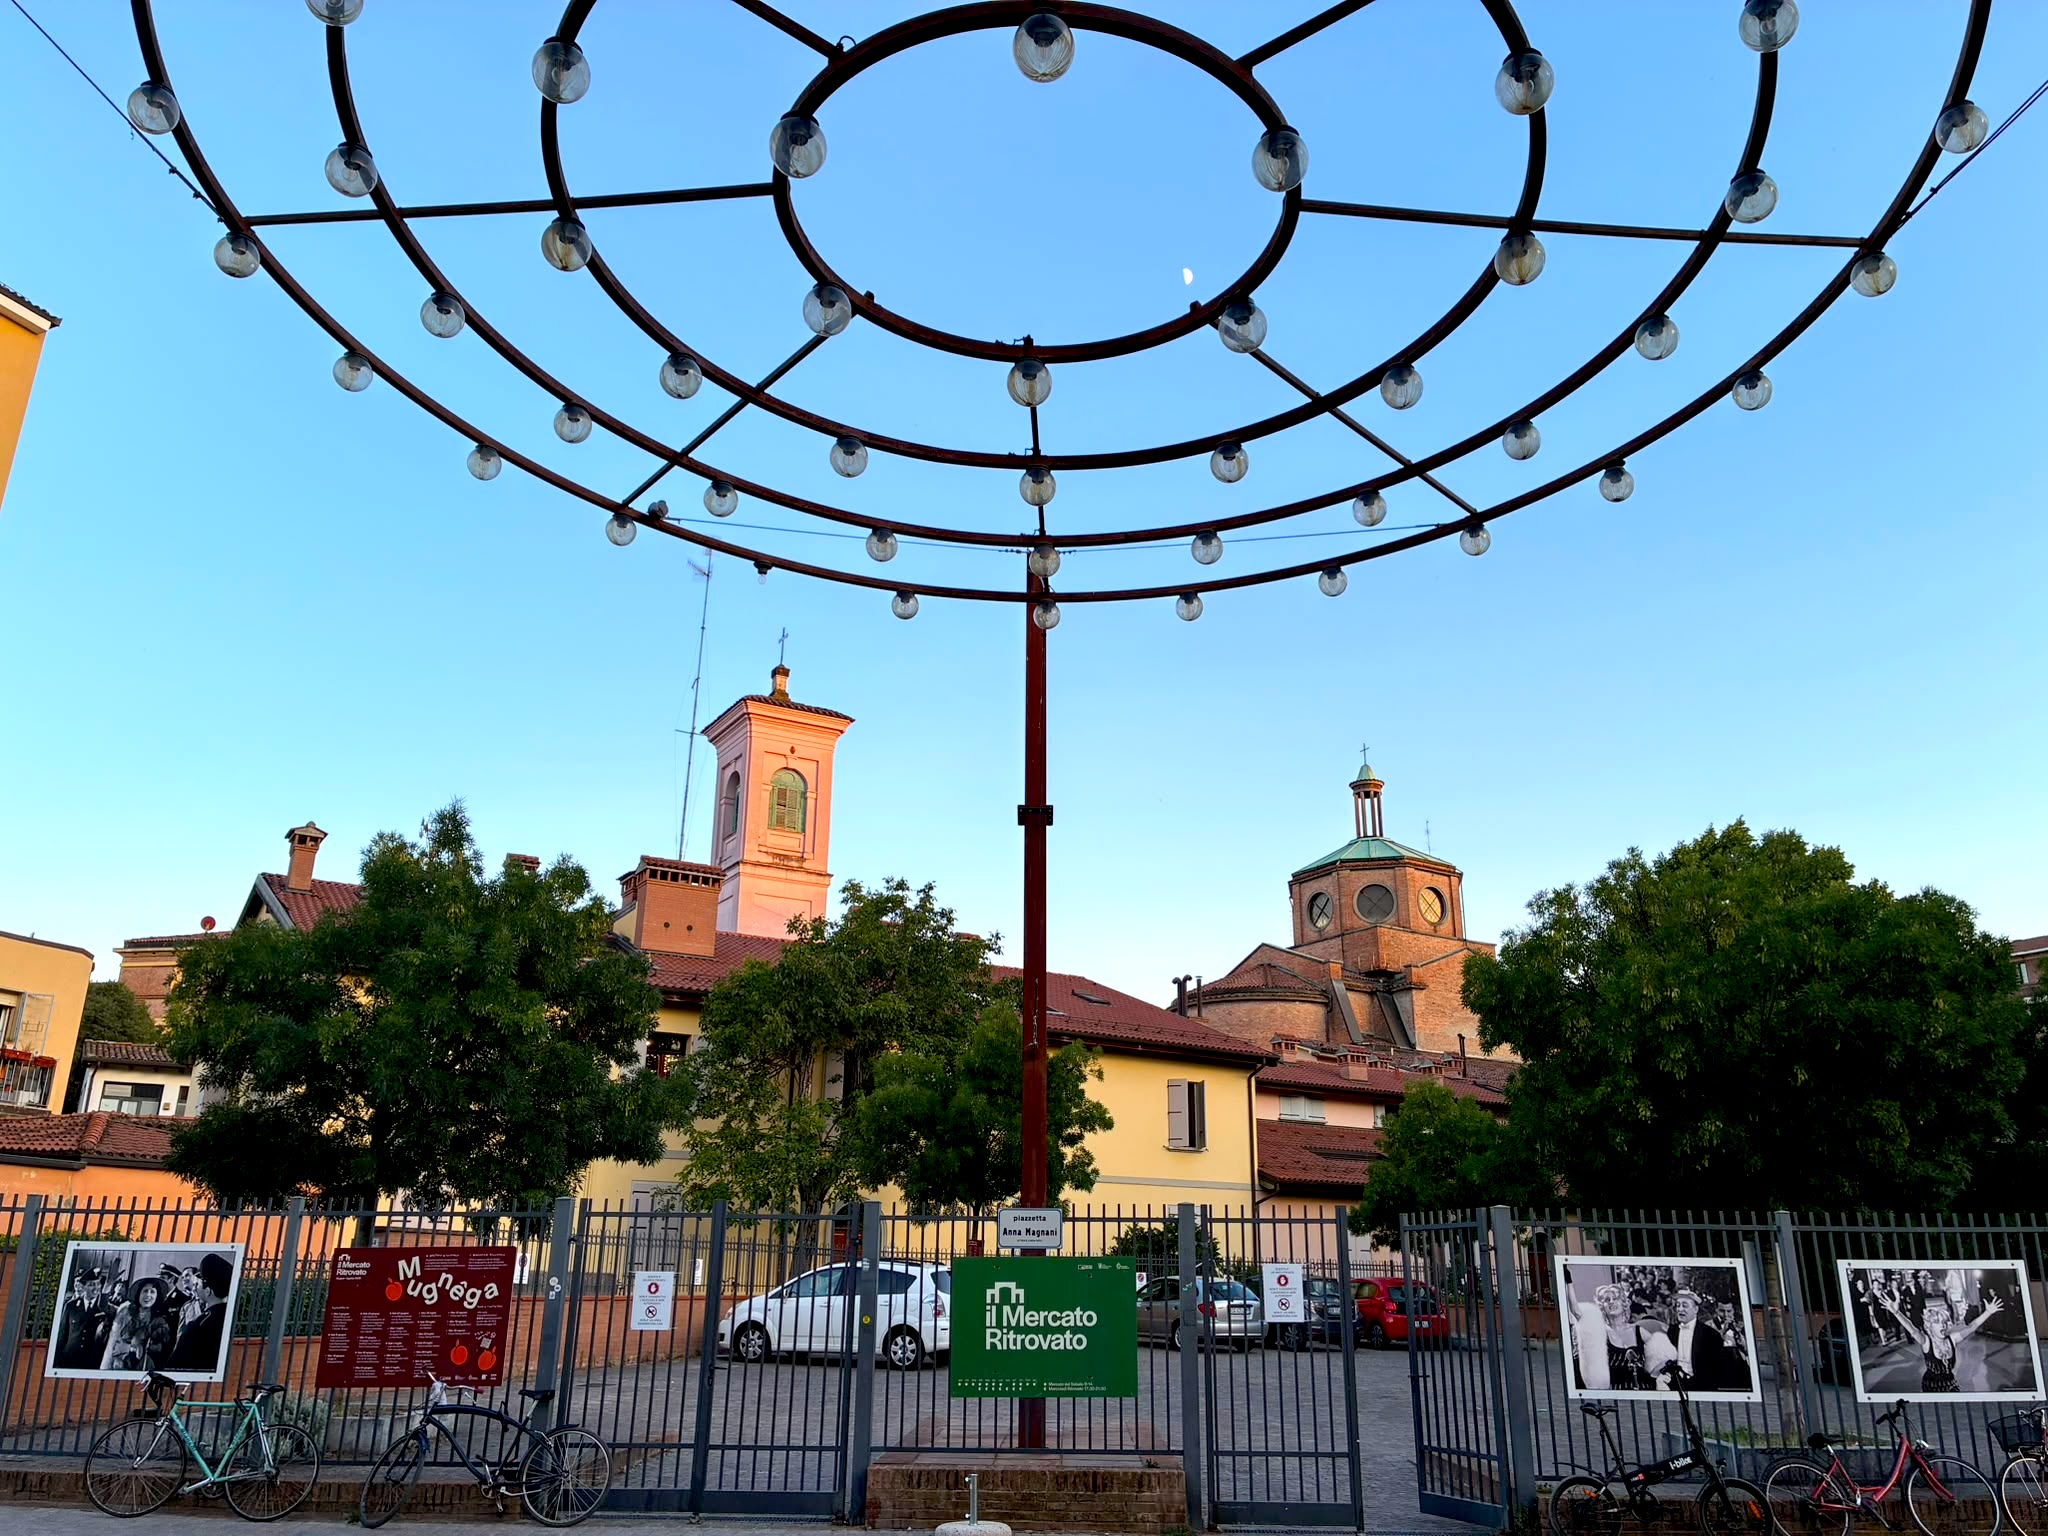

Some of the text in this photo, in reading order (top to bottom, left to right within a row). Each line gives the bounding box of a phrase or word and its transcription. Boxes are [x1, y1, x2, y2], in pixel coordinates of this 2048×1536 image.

[1002, 1227, 1058, 1237] Anna Magnani
[985, 1305, 1098, 1327] il Mercato
[985, 1328, 1088, 1351] Ritrovato
